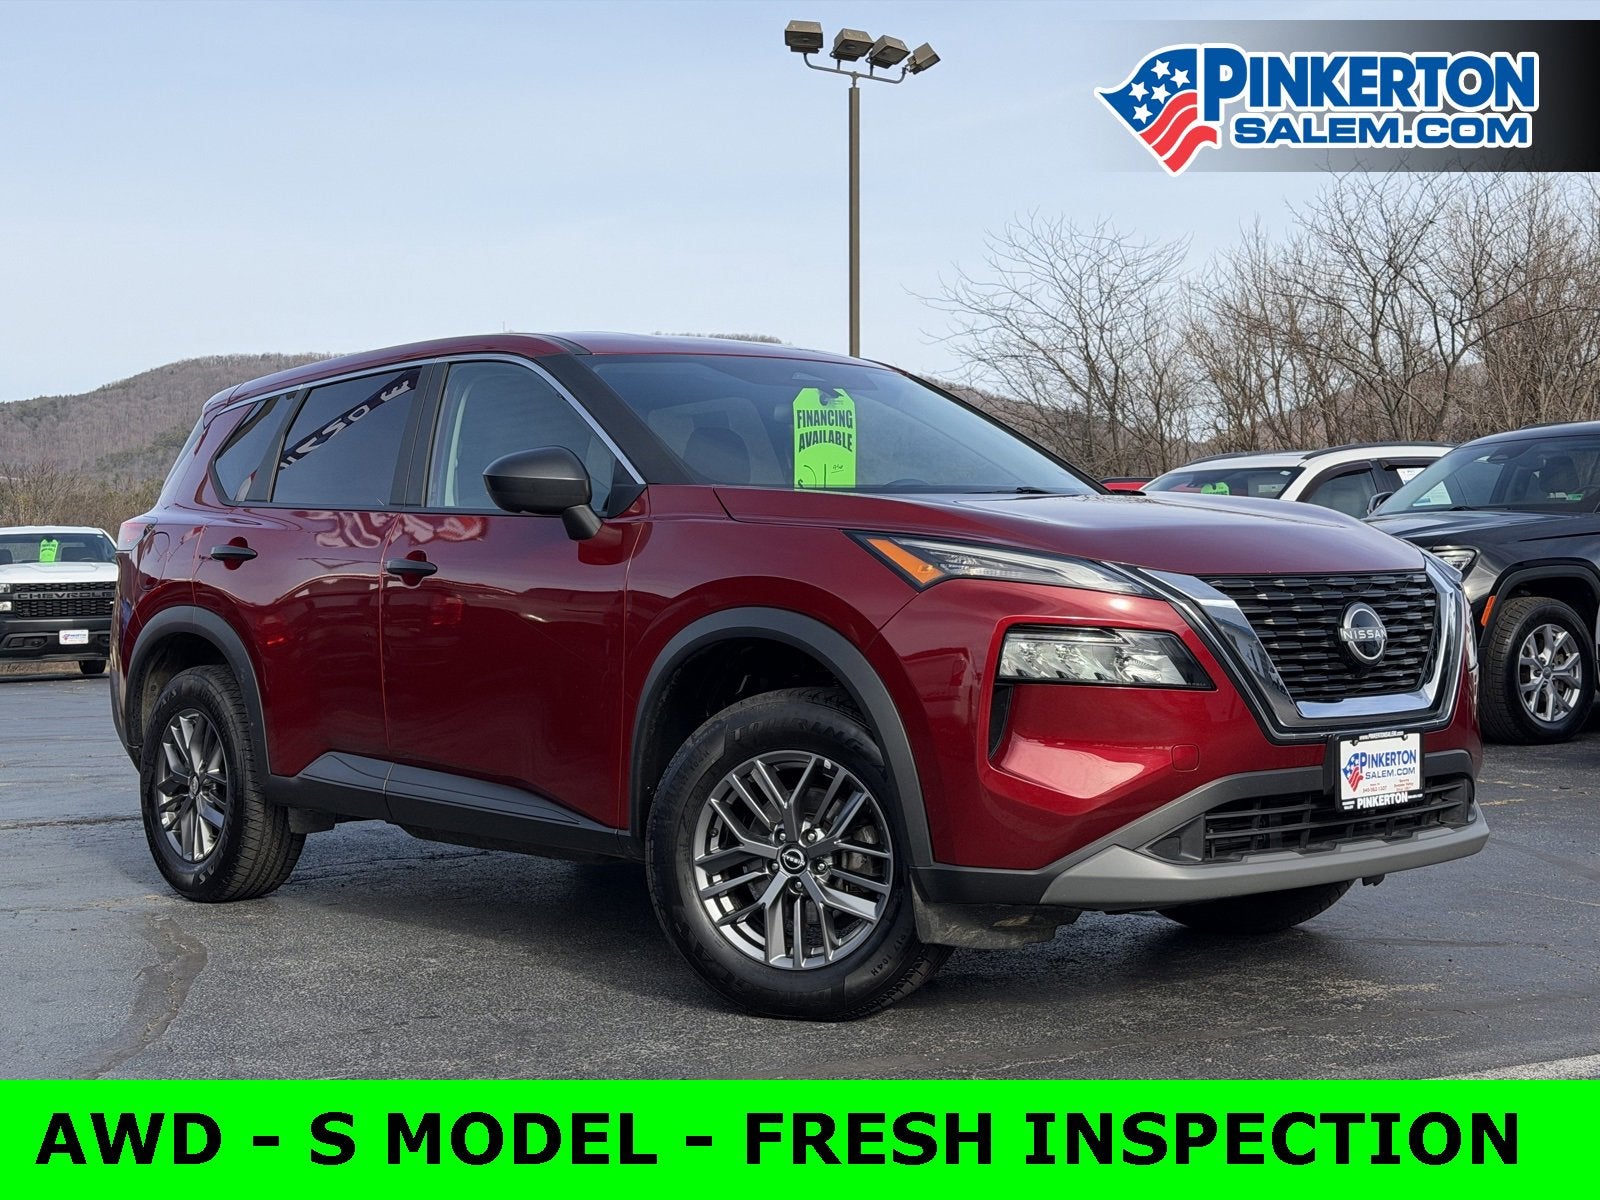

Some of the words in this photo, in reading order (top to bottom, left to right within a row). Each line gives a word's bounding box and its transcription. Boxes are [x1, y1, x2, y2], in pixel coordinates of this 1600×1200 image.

[796, 409, 853, 429] FINANCING
[798, 429, 853, 453] AVAILABLE
[17, 591, 116, 600] CHEVROLE
[1342, 628, 1387, 640] NISSAN
[1359, 749, 1417, 774] PINKERTON
[1365, 767, 1416, 780] SALEM.COM
[1357, 791, 1408, 810] PINKERTON
